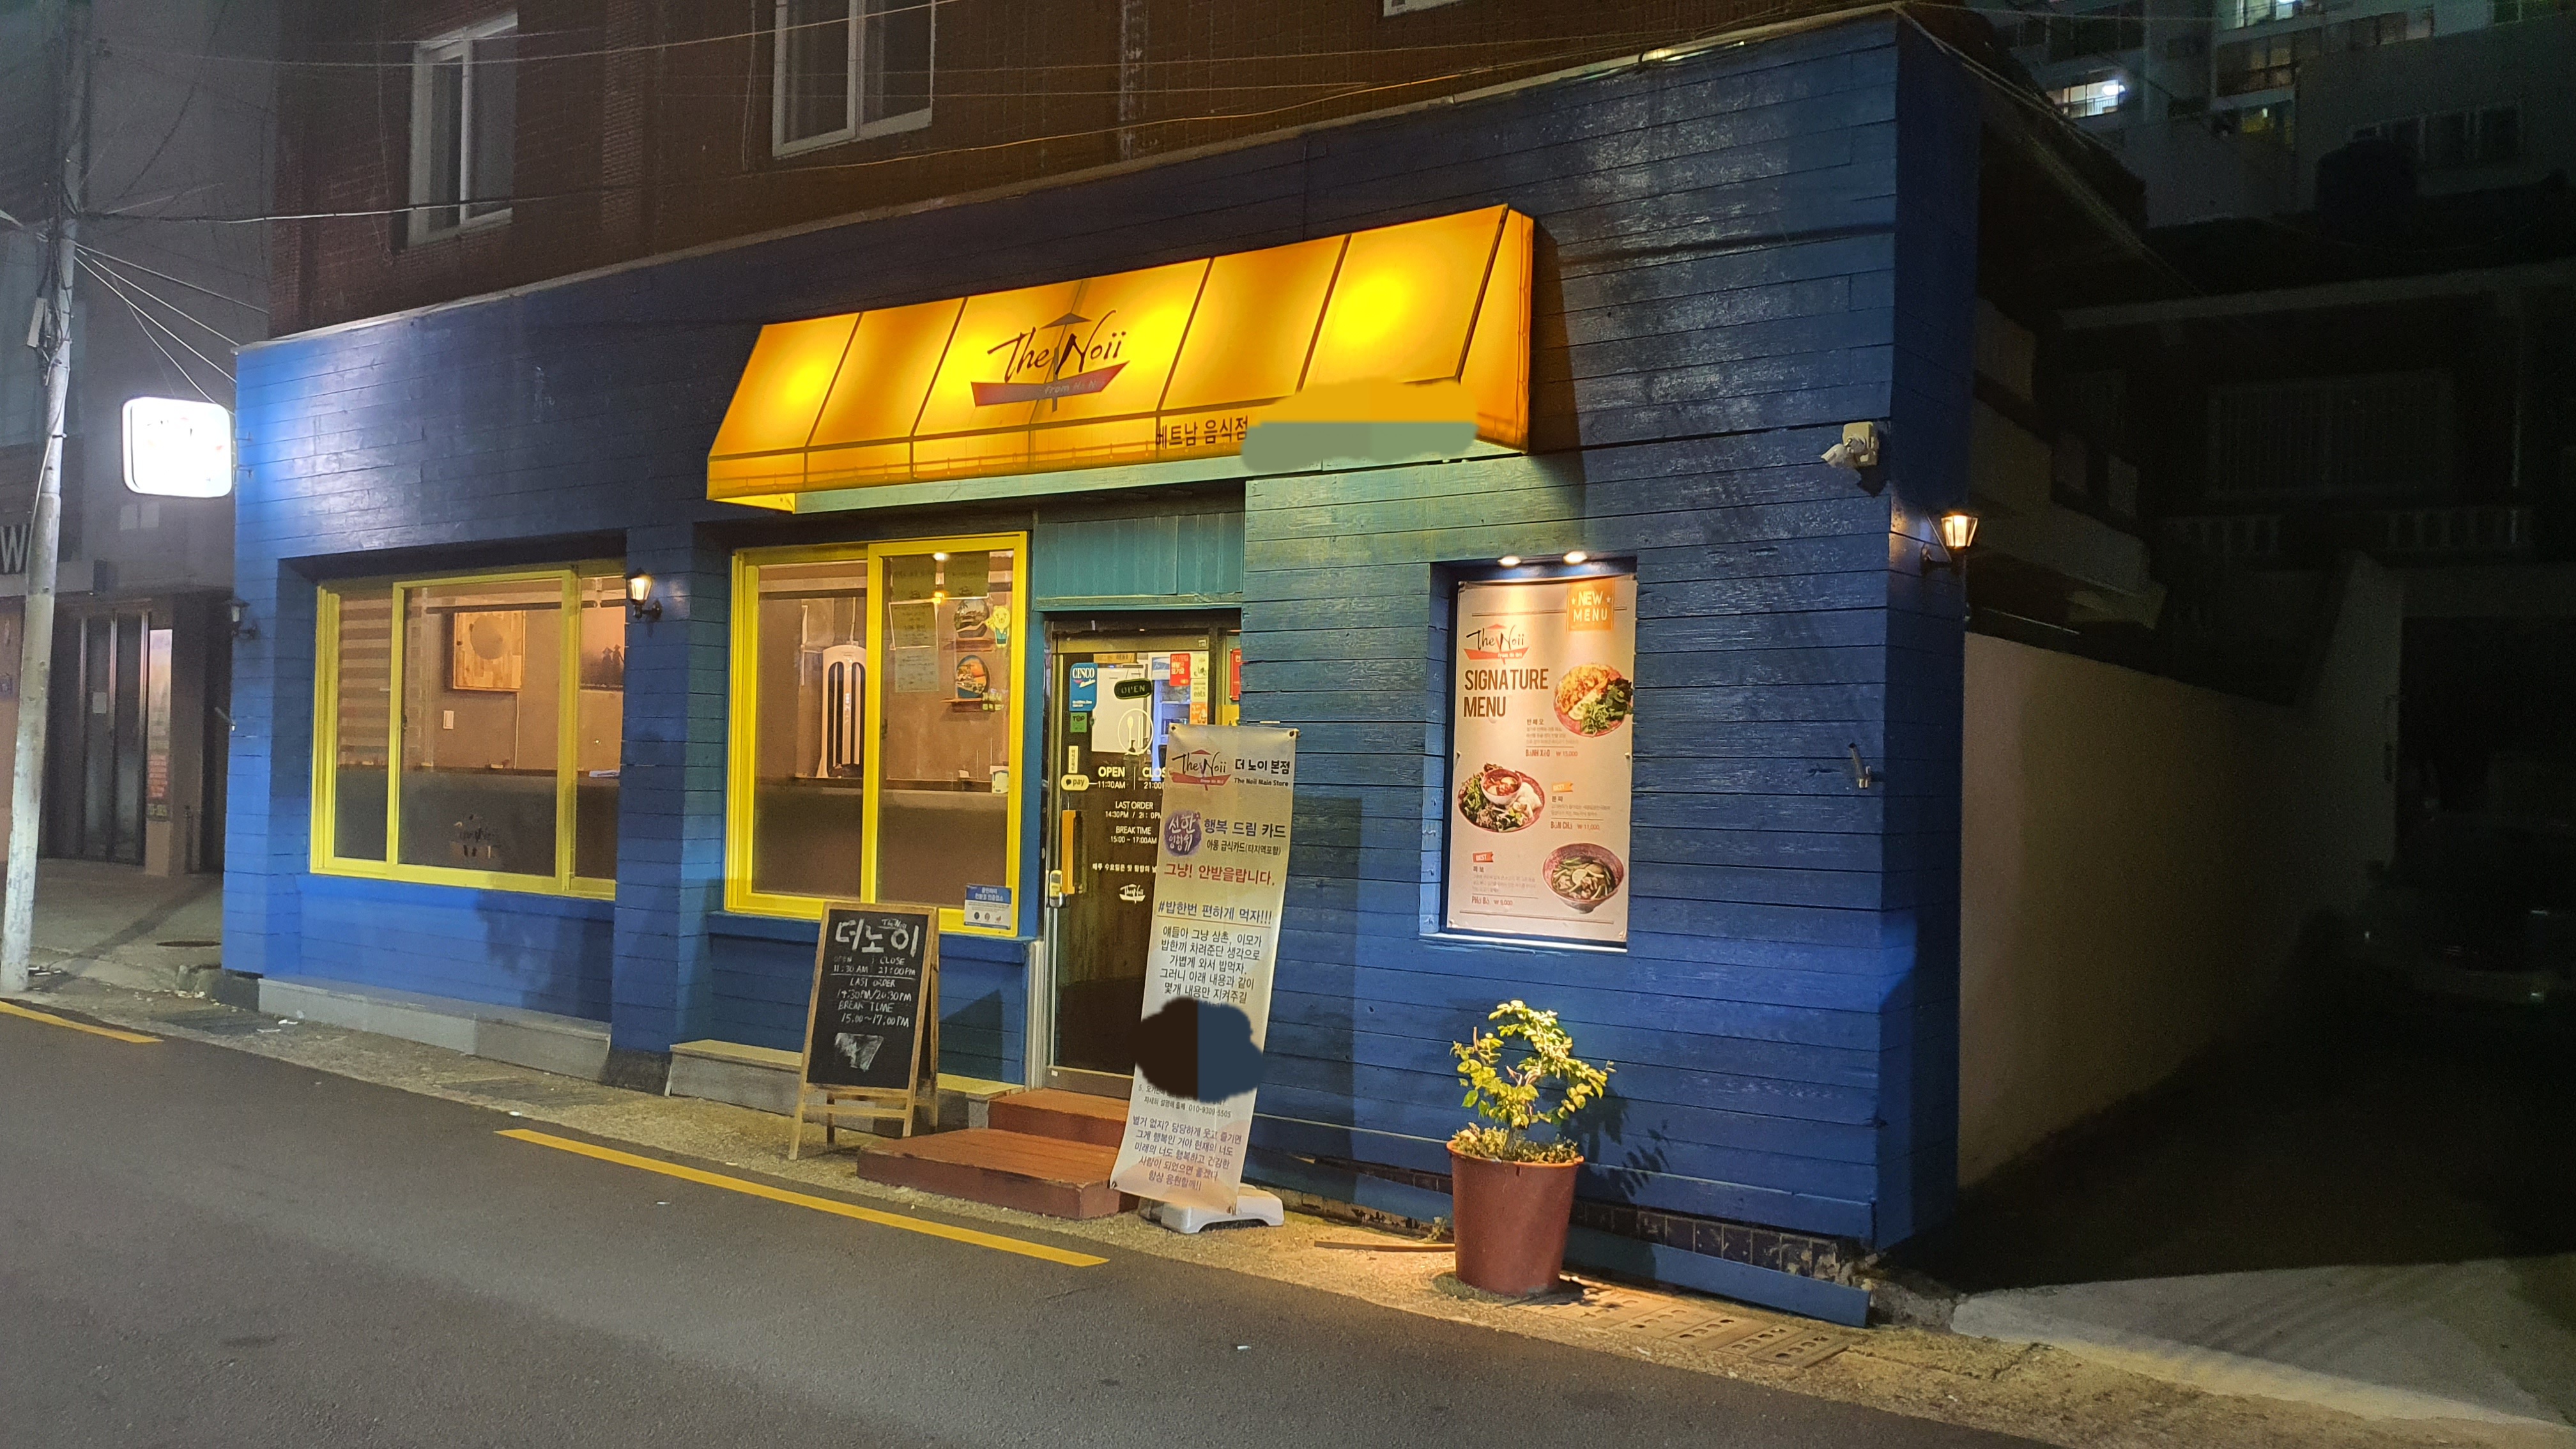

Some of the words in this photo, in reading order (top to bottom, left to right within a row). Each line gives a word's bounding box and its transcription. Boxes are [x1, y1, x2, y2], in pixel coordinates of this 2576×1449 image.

[987, 326, 1054, 383] The
[1055, 309, 1126, 375] Noii
[1156, 422, 1198, 449] 베트남
[1204, 415, 1248, 444] 음식점
[0, 524, 27, 574] W
[1577, 591, 1604, 606] NEW
[1572, 608, 1608, 622] MENU
[1466, 627, 1496, 651] The
[1499, 624, 1524, 650] Noii
[1072, 668, 1094, 678] CESCO
[1464, 668, 1549, 691] SIGNATURE
[1121, 685, 1146, 694] OPEN
[1463, 696, 1506, 717] MENU
[1098, 767, 1126, 778] OPEN
[1142, 767, 1167, 778] CLOS
[1171, 753, 1199, 774] The
[1203, 751, 1227, 776] Noii
[1235, 758, 1245, 770] 더
[1248, 760, 1268, 771] 노이
[1271, 760, 1290, 774] 본점
[1073, 778, 1085, 786] pay
[1098, 781, 1126, 789] 11:30AM
[1115, 801, 1130, 809] LAST
[1131, 801, 1154, 810] ORDER
[1116, 825, 1135, 834] BREAK
[1204, 818, 1228, 834] 행복
[1232, 822, 1257, 837] 드림
[1262, 824, 1286, 838] 카드
[1164, 863, 1193, 878] 그냥!
[1198, 864, 1275, 886] 안받을랍니다.
[1158, 900, 1197, 916] #밥한번
[1202, 904, 1234, 920] 편하게
[1239, 908, 1272, 924] 먹자!!!
[1192, 929, 1209, 942] 그냥
[1237, 933, 1262, 947] 이모가
[1161, 939, 1187, 953] 밥한끼
[1190, 942, 1224, 957] 차려준단
[1227, 946, 1261, 961] 생각으로
[880, 956, 905, 965] CLOSE
[1169, 954, 1195, 968] 가볍게
[1199, 958, 1215, 970] 와서
[1219, 960, 1247, 975] 밥먹자.
[850, 977, 868, 986] LAST
[873, 979, 896, 987] ORDER
[1160, 968, 1186, 981] 그러니
[1189, 970, 1206, 984] 아래
[1209, 974, 1234, 988] 내용과
[1238, 976, 1255, 990] 같이
[1165, 982, 1181, 995] 몇개
[1184, 985, 1210, 999] 내용만
[1213, 989, 1247, 1004] 지켜주길
[838, 1000, 864, 1010] BREAK
[870, 1002, 894, 1013] TIME
[1133, 1116, 1147, 1127] 별거
[1150, 1117, 1169, 1130] 없지?
[1172, 1123, 1201, 1137] 당당하게
[1203, 1129, 1218, 1140] 웃고
[1220, 1132, 1242, 1145] 즐기면
[1136, 1130, 1151, 1140] 그게
[1153, 1132, 1176, 1145] 행복인
[1195, 1140, 1216, 1151] 현재의
[1219, 1145, 1234, 1156] 너도
[1135, 1142, 1156, 1154] 미래의
[1159, 1147, 1173, 1158] 너도
[1176, 1149, 1205, 1164] 행복하고
[1208, 1156, 1230, 1170] 건강한
[1138, 1155, 1162, 1169] 사람이
[1163, 1161, 1193, 1175] 되었으면
[1149, 1170, 1163, 1183] 항상
